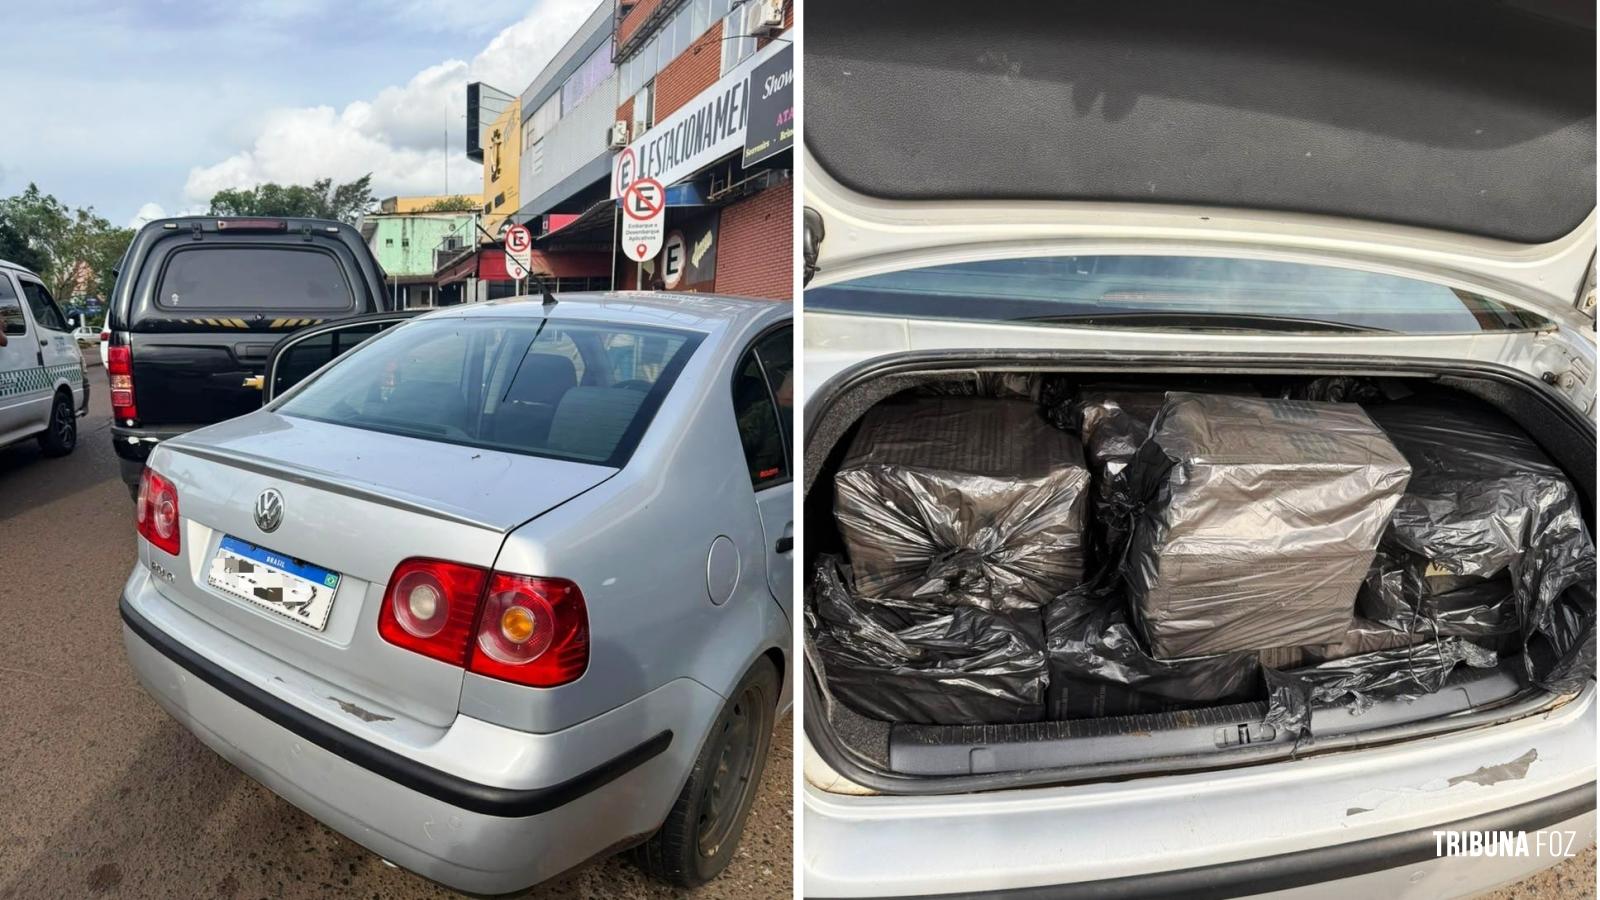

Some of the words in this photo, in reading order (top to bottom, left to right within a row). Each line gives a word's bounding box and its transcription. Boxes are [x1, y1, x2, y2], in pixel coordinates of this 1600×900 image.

[635, 186, 655, 212] E
[666, 242, 681, 276] E
[266, 555, 286, 570] BRASIL
